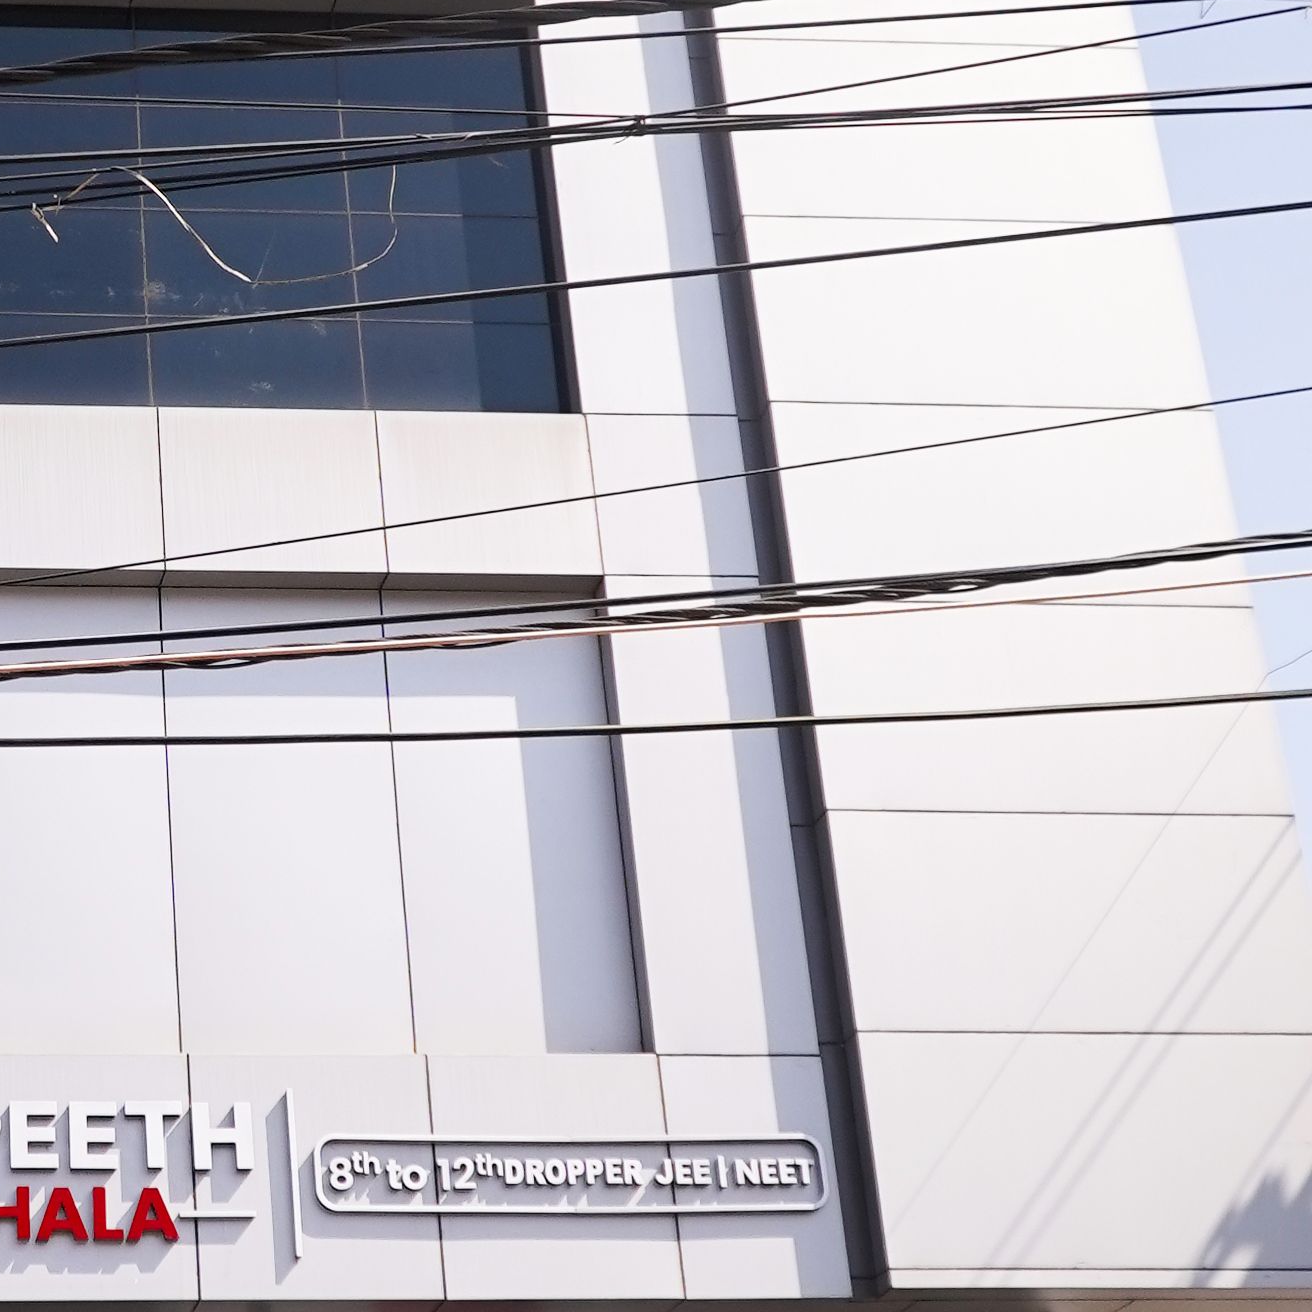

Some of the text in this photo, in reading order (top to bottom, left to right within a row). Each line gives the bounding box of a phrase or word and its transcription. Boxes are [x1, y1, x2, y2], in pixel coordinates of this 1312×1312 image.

[386, 1158, 428, 1191] to
[504, 1157, 643, 1187] DROPPER
[654, 1157, 712, 1187] JEE
[735, 1157, 813, 1187] NEET
